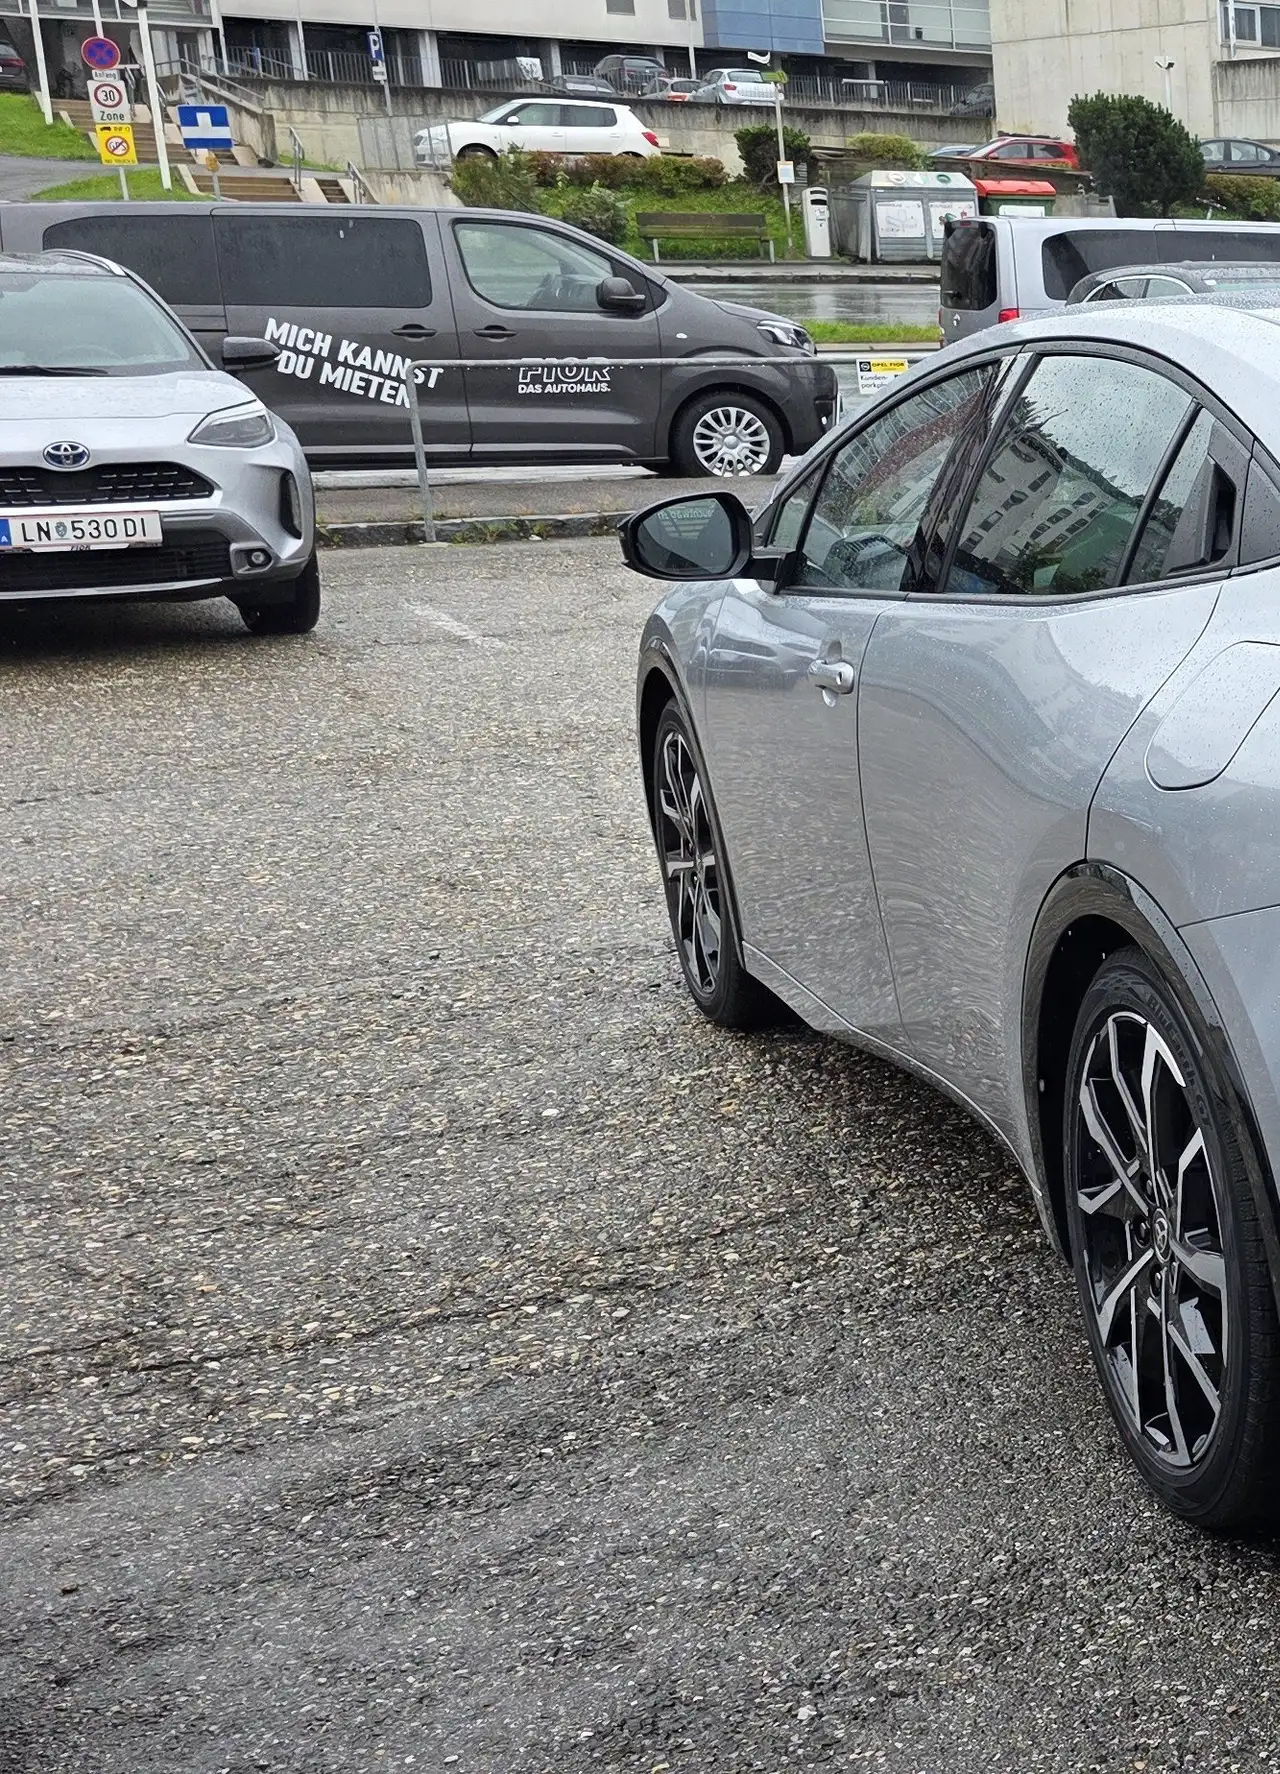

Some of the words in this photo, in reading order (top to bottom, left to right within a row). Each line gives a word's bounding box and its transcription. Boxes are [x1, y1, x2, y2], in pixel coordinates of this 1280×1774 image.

[369, 34, 380, 58] P
[101, 90, 115, 101] 30
[100, 110, 124, 121] Zone
[264, 317, 333, 357] MICH
[277, 350, 314, 379] DU
[338, 340, 444, 389] KANNST
[319, 362, 411, 408] MIETEN
[518, 384, 542, 393] DAS
[544, 383, 611, 393] AUTOHAUS.
[21, 521, 51, 542] LN
